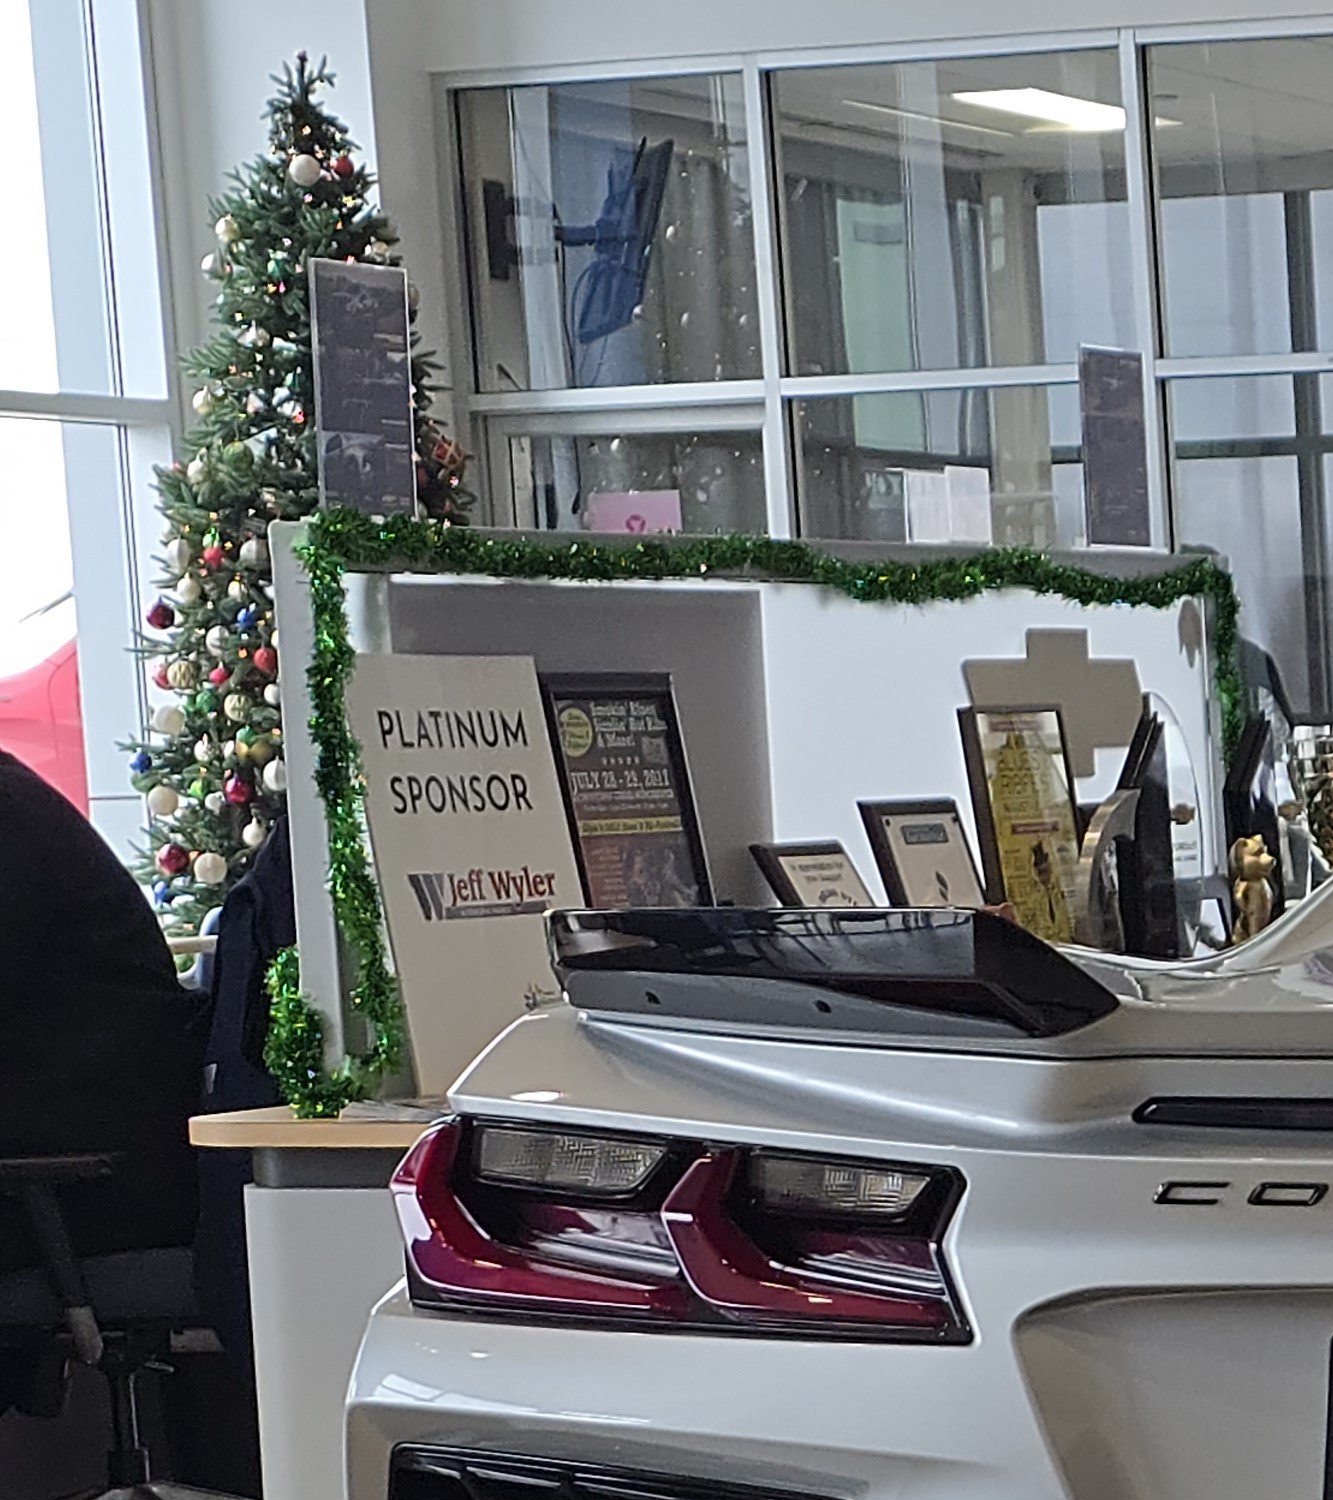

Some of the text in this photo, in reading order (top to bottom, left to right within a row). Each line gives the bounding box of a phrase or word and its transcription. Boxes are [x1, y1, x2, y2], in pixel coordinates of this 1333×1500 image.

[377, 709, 528, 750] PLATINUM
[390, 773, 533, 814] SPONSOR
[570, 771, 602, 795] JULY
[448, 869, 485, 907] Jeff
[488, 866, 555, 905] Wyler
